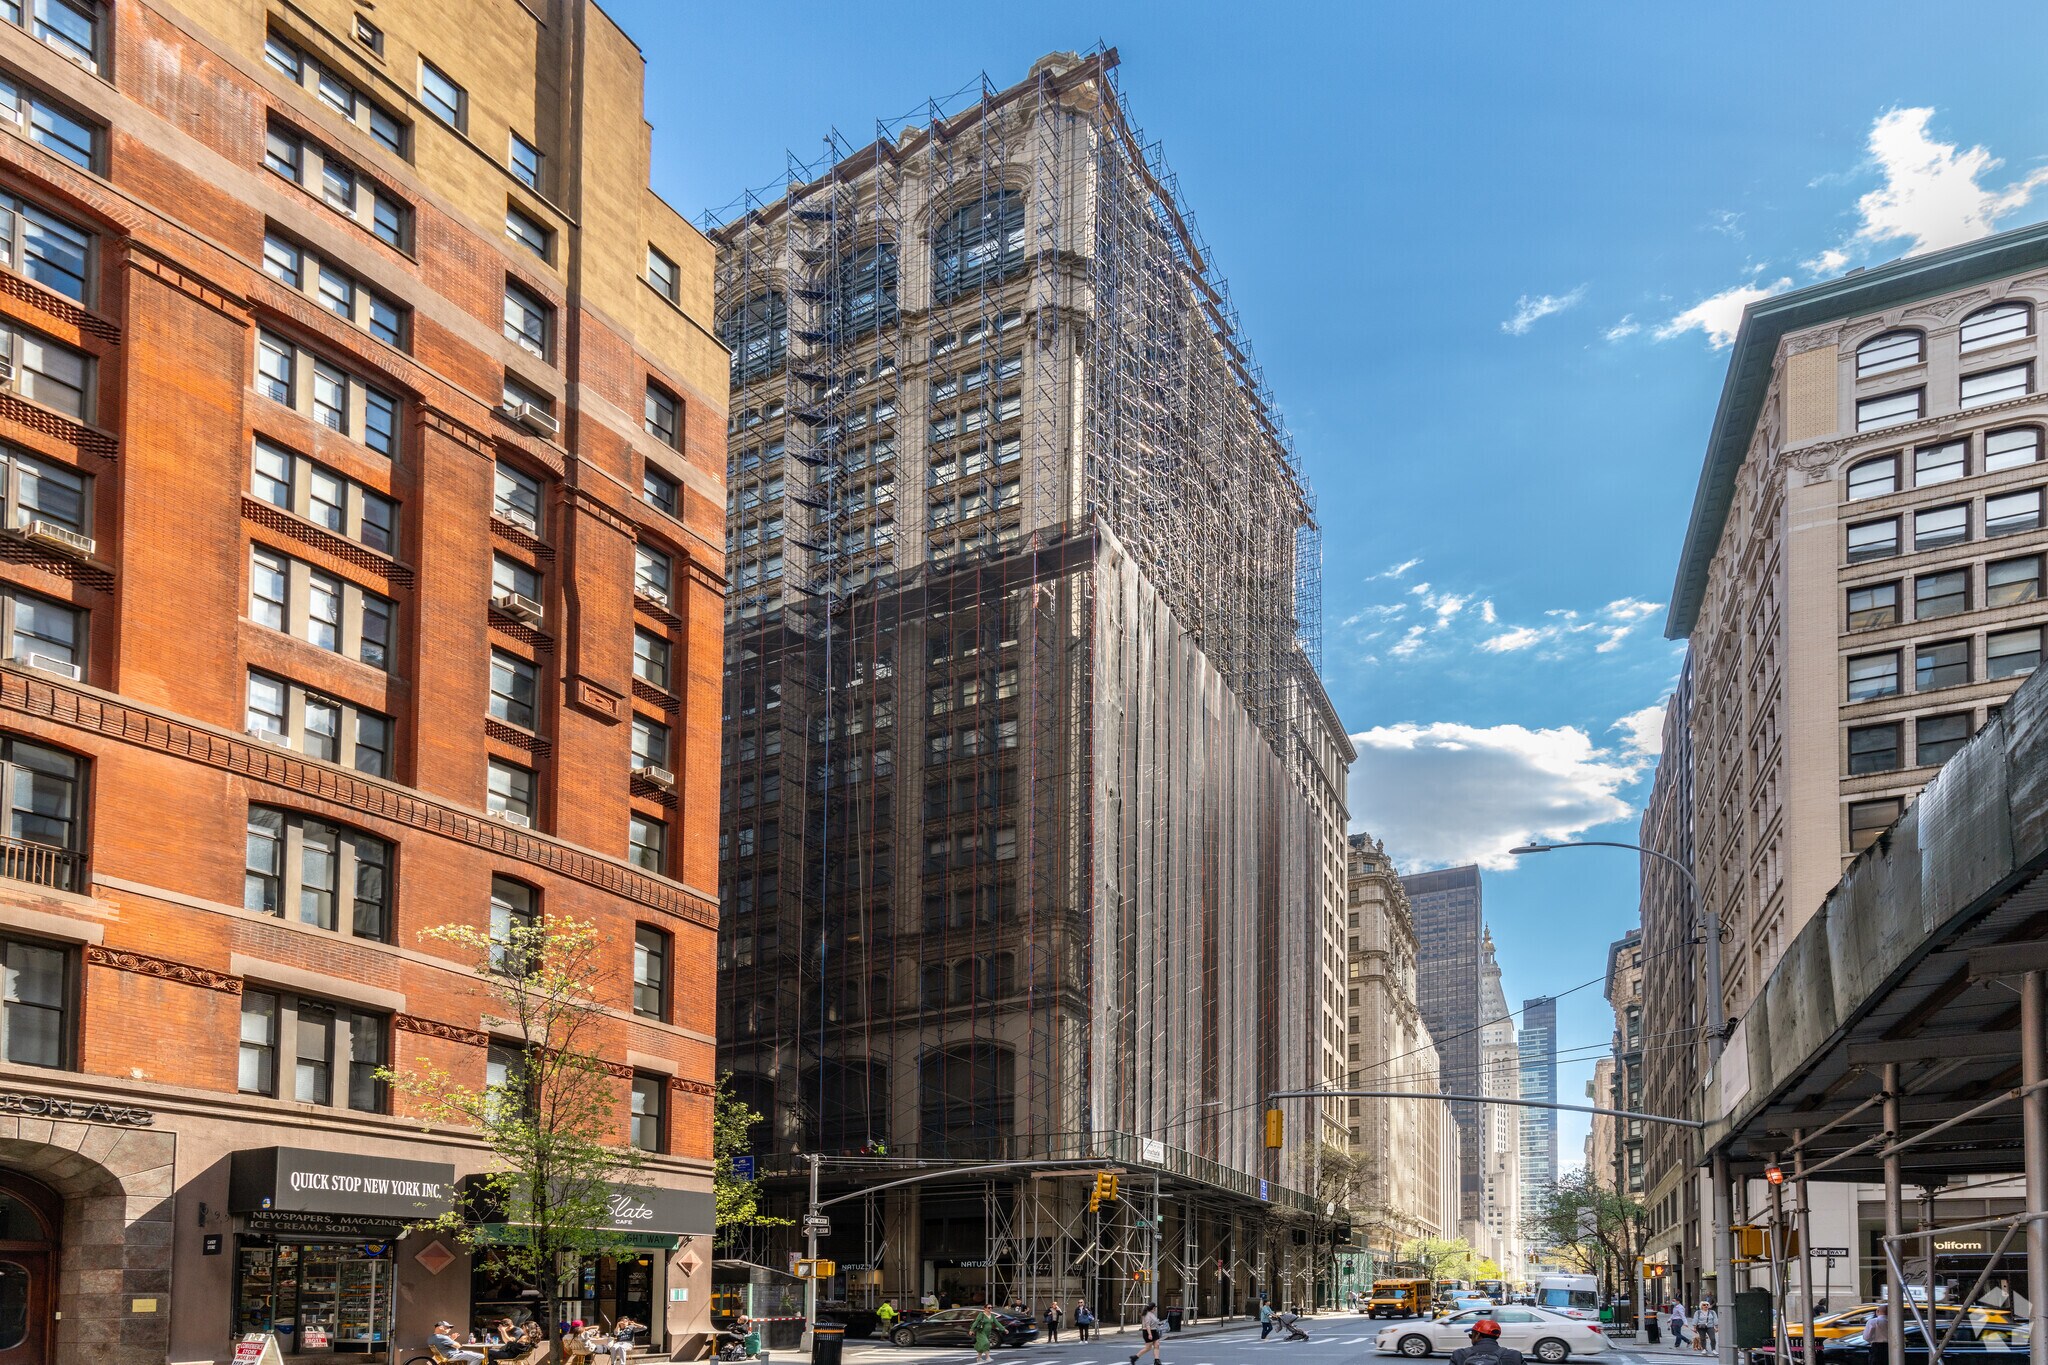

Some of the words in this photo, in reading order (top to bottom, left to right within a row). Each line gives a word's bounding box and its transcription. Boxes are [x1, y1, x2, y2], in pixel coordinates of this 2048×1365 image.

[291, 1171, 329, 1191] QUICK
[331, 1175, 361, 1192] STOP
[363, 1178, 389, 1194] NEW
[391, 1181, 420, 1197] YORK
[422, 1183, 442, 1198] INC.
[606, 1194, 653, 1219] Slate
[252, 1211, 334, 1224] NEWSPAPERS,
[250, 1220, 271, 1229] ICE
[274, 1222, 322, 1232] CREAM,
[325, 1224, 361, 1234] SODA,
[646, 1234, 665, 1243] WAY
[1934, 1241, 1982, 1249] oliform
